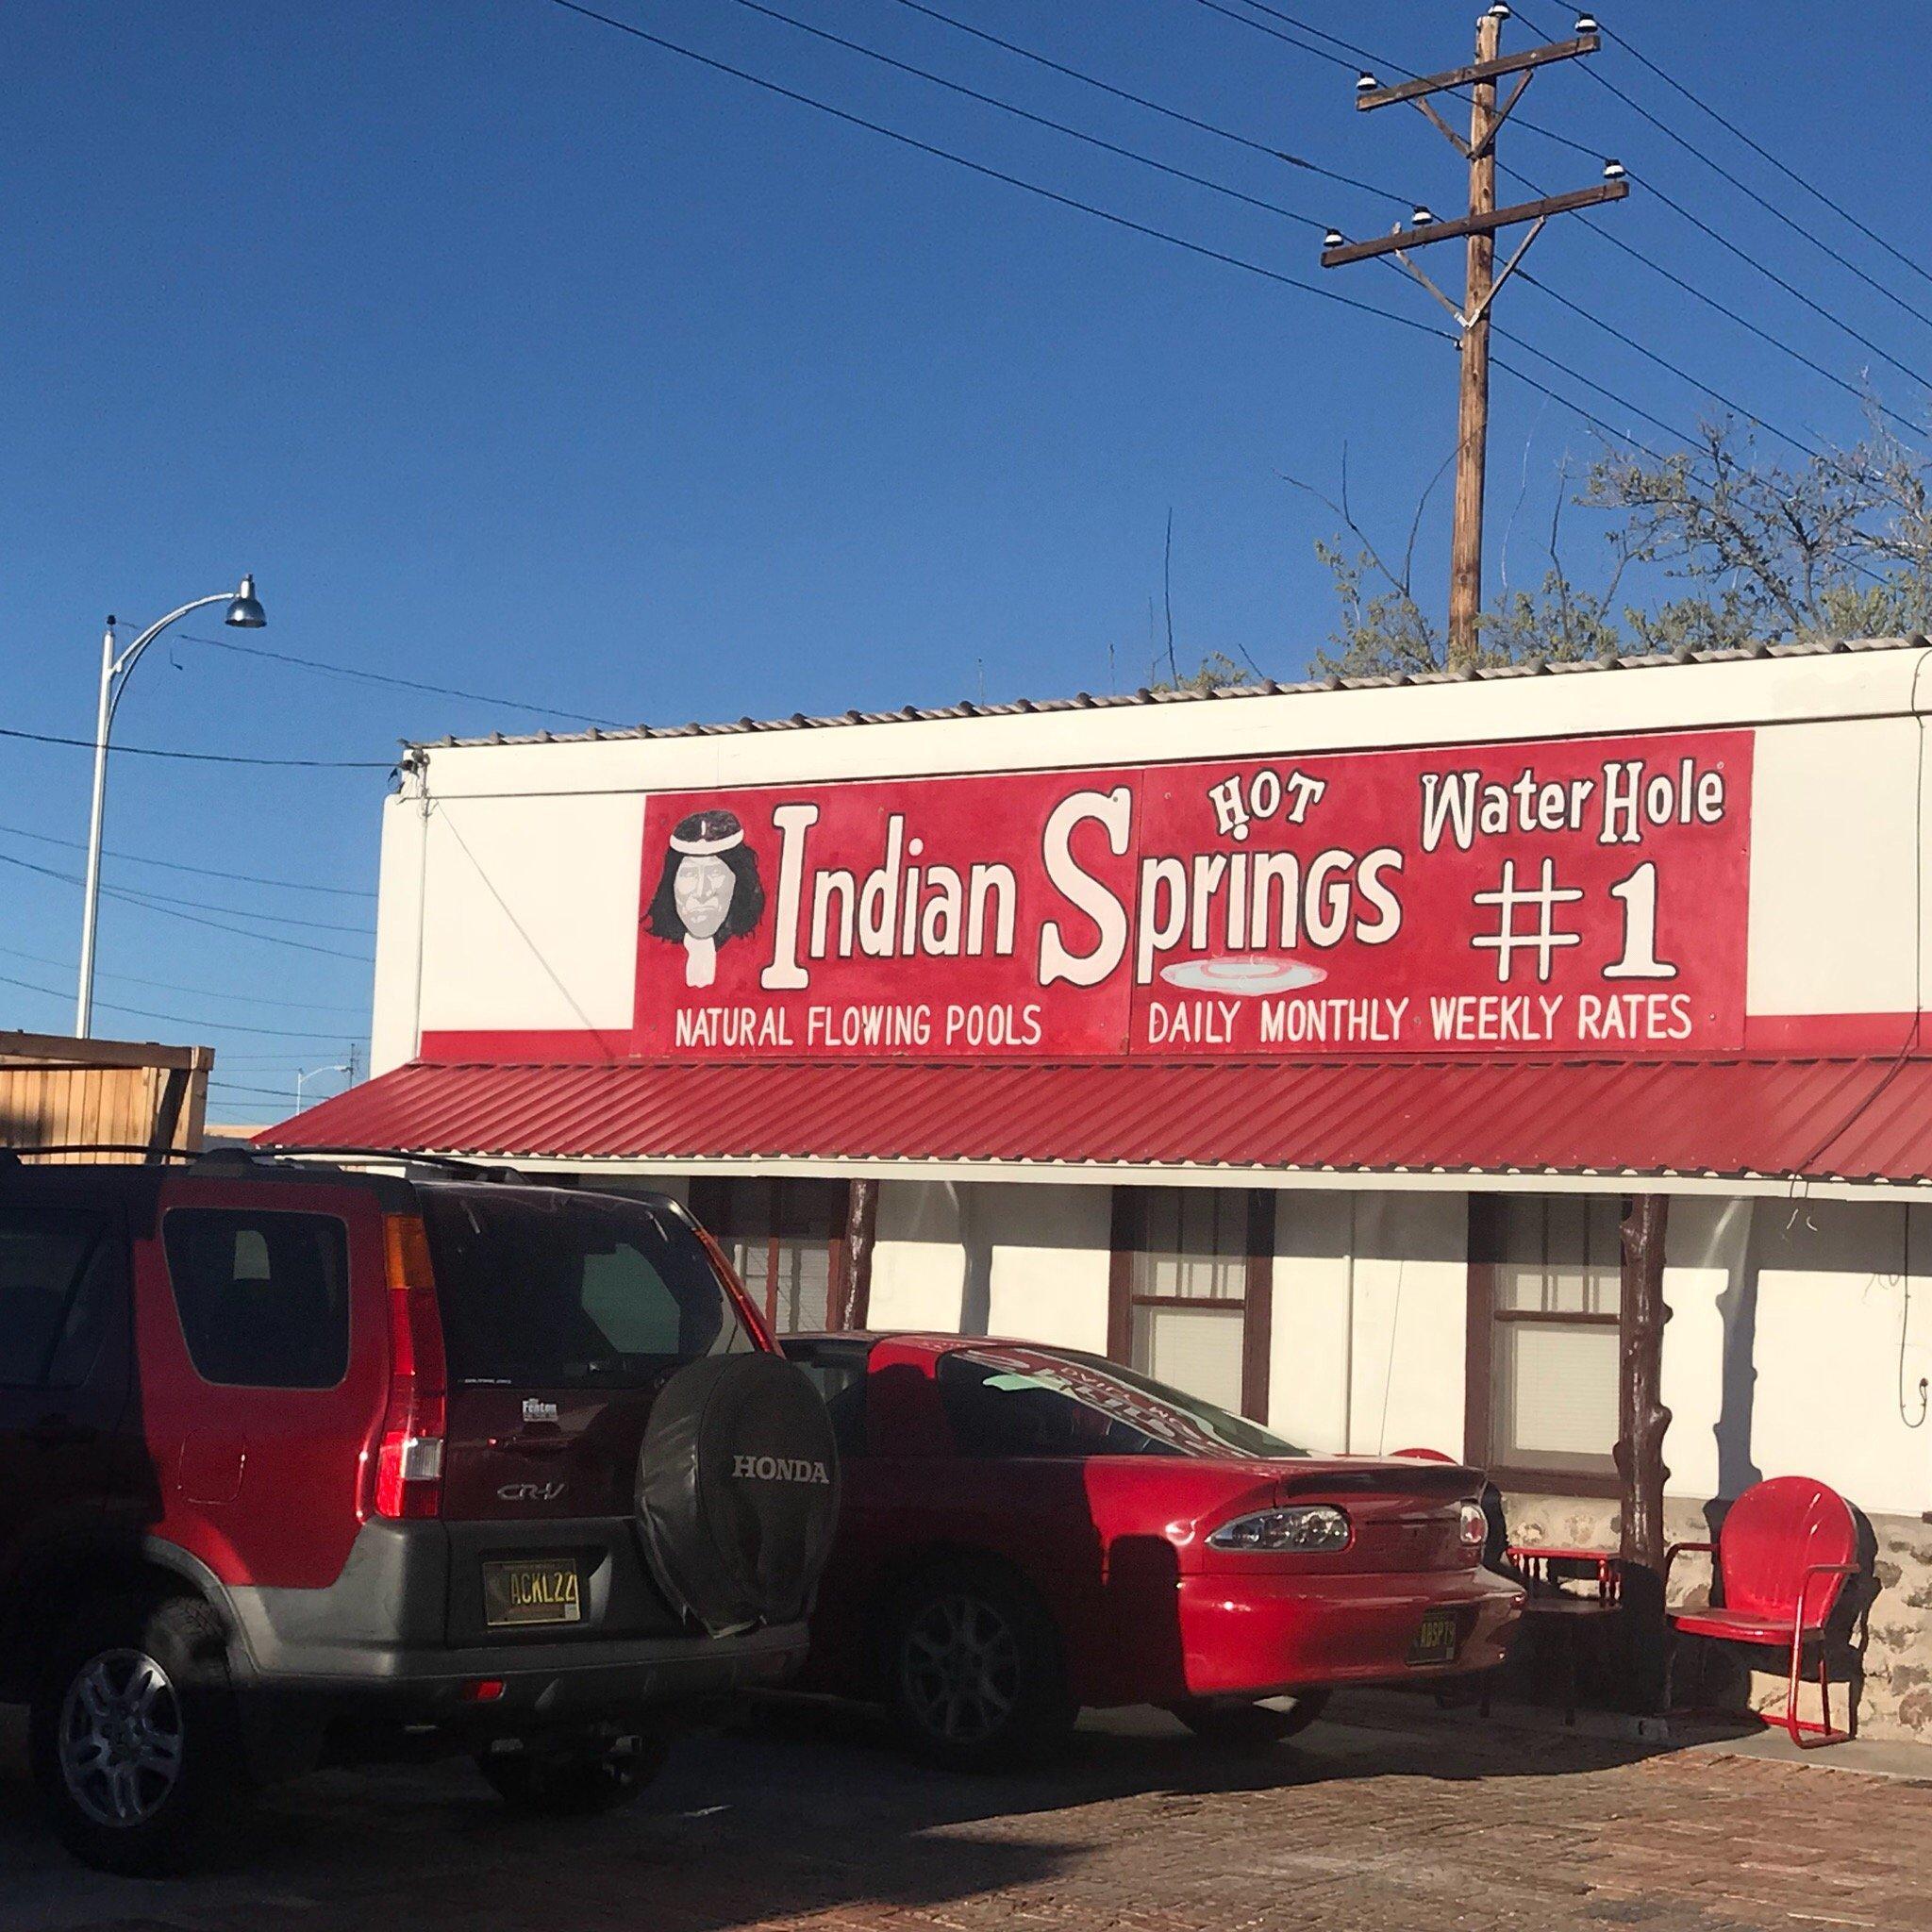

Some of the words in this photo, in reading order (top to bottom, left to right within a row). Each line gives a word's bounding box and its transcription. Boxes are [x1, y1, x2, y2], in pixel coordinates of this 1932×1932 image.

[1208, 770, 1326, 836] HOT
[1420, 768, 1595, 853] Water
[1598, 758, 1724, 844] Hole
[759, 804, 1017, 990] Indian
[675, 1006, 793, 1047] NATURAL
[808, 1004, 931, 1047] FLOWING
[946, 1004, 1041, 1046] POOLS
[1148, 1000, 1241, 1044] DAILY
[1260, 997, 1409, 1042] MONTHLY
[1430, 994, 1563, 1041] WEEKLY
[1578, 993, 1692, 1040] RATES
[497, 1481, 565, 1501] CR-V
[731, 1455, 830, 1485] HONDA
